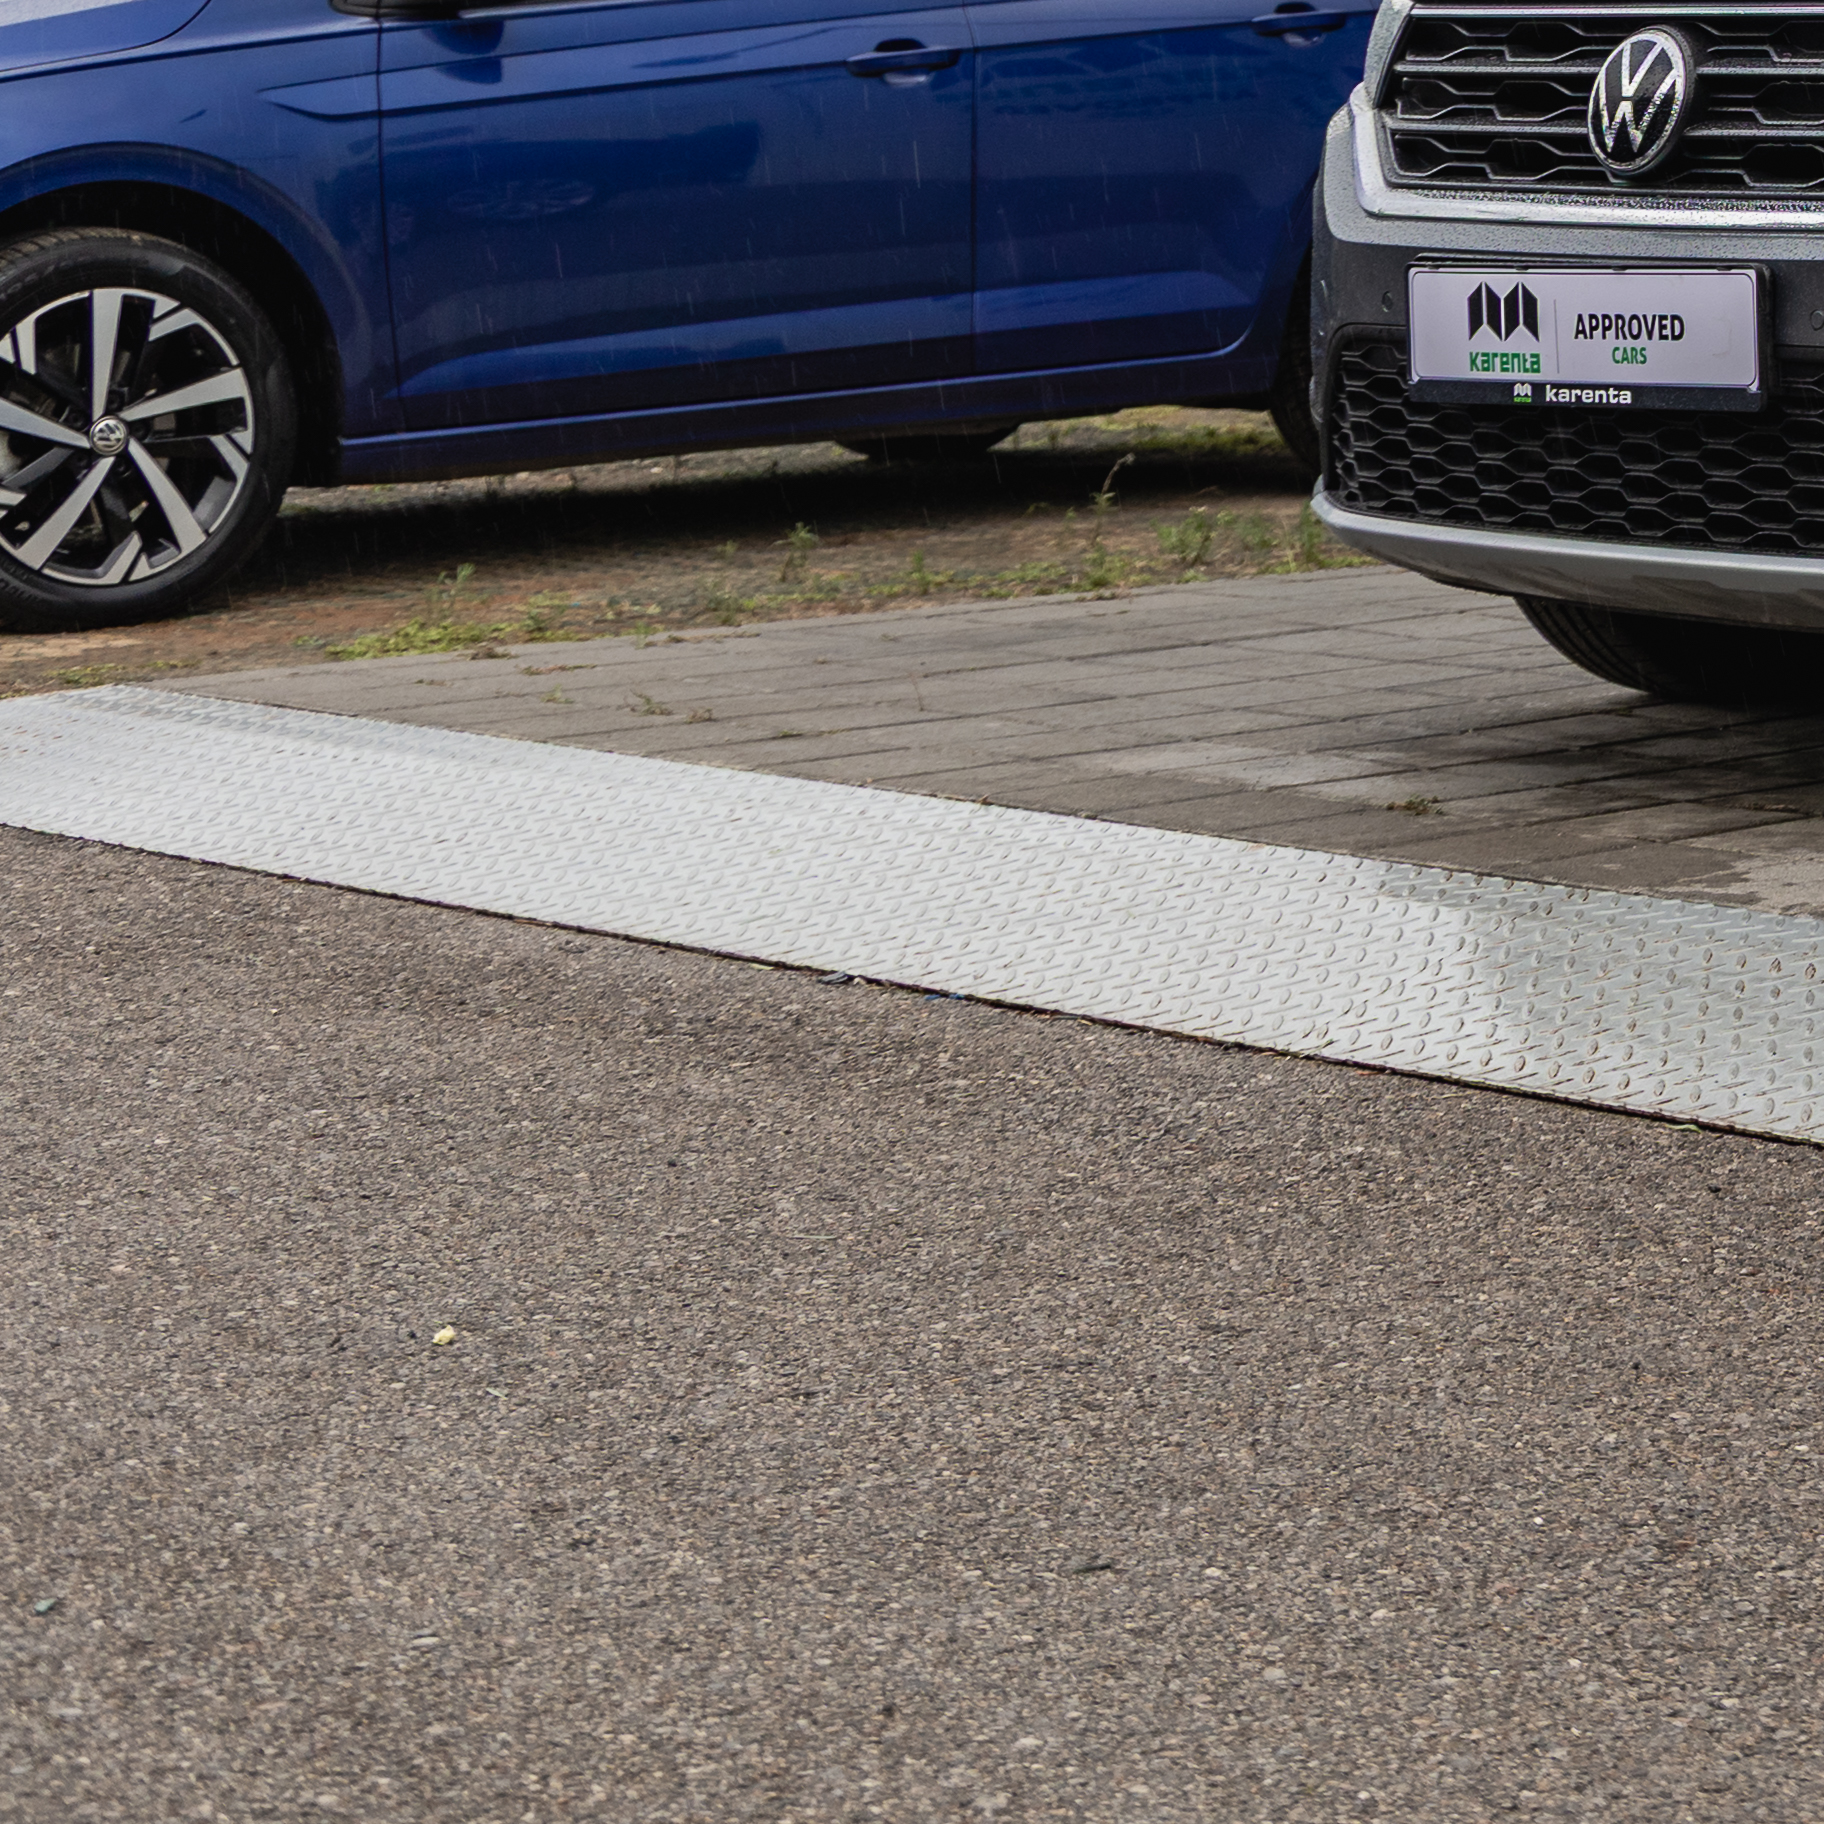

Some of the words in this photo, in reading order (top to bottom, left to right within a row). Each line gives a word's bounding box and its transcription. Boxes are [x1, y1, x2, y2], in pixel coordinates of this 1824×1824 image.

[1574, 313, 1685, 342] APPROVED
[1611, 346, 1647, 365] CARS
[1545, 384, 1632, 405] karenta
